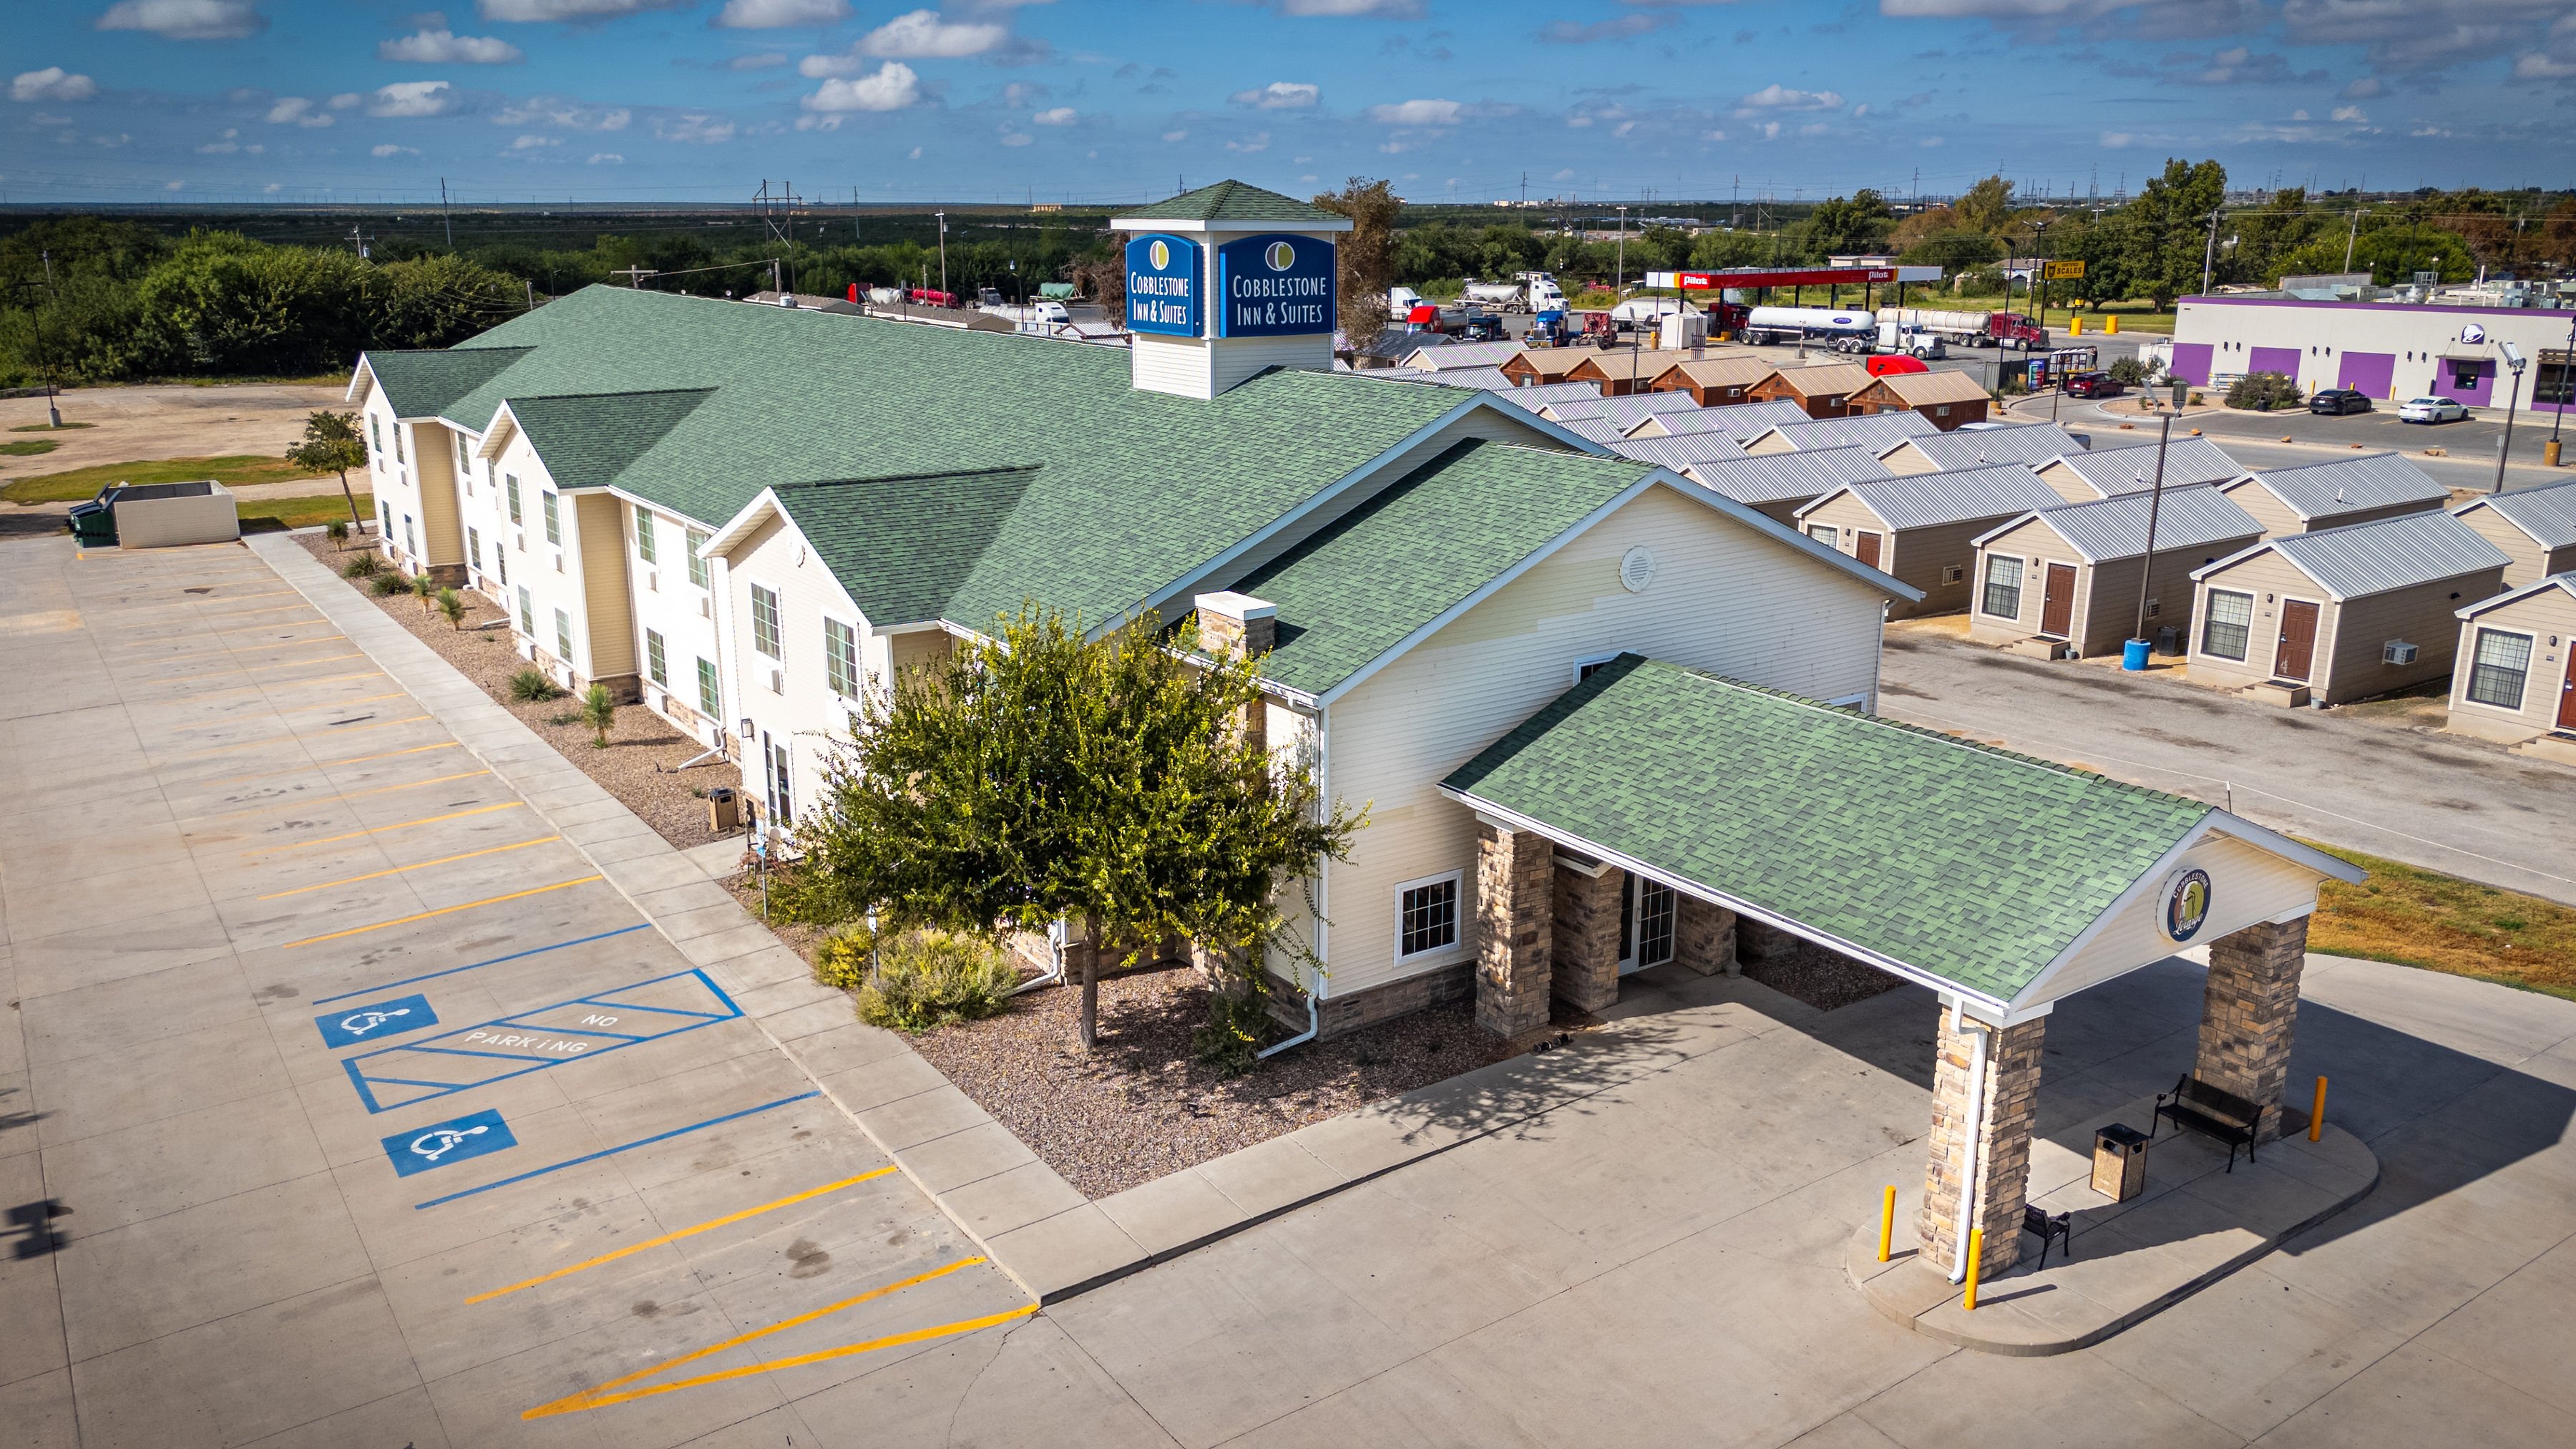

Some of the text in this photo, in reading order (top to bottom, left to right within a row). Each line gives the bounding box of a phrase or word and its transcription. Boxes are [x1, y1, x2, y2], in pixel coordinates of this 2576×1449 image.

[1131, 271, 1189, 297] COBBLESTONE
[1233, 275, 1327, 298] COBBLESTONE
[1684, 275, 1708, 286] Pilot
[1868, 271, 1889, 280] Pilot
[1133, 298, 1187, 325] INN & SUITES
[1237, 301, 1323, 326] INN & SUITES
[2172, 872, 2209, 899] COBBLESTONE
[2172, 912, 2204, 935] Lounge
[581, 1014, 618, 1027] NO
